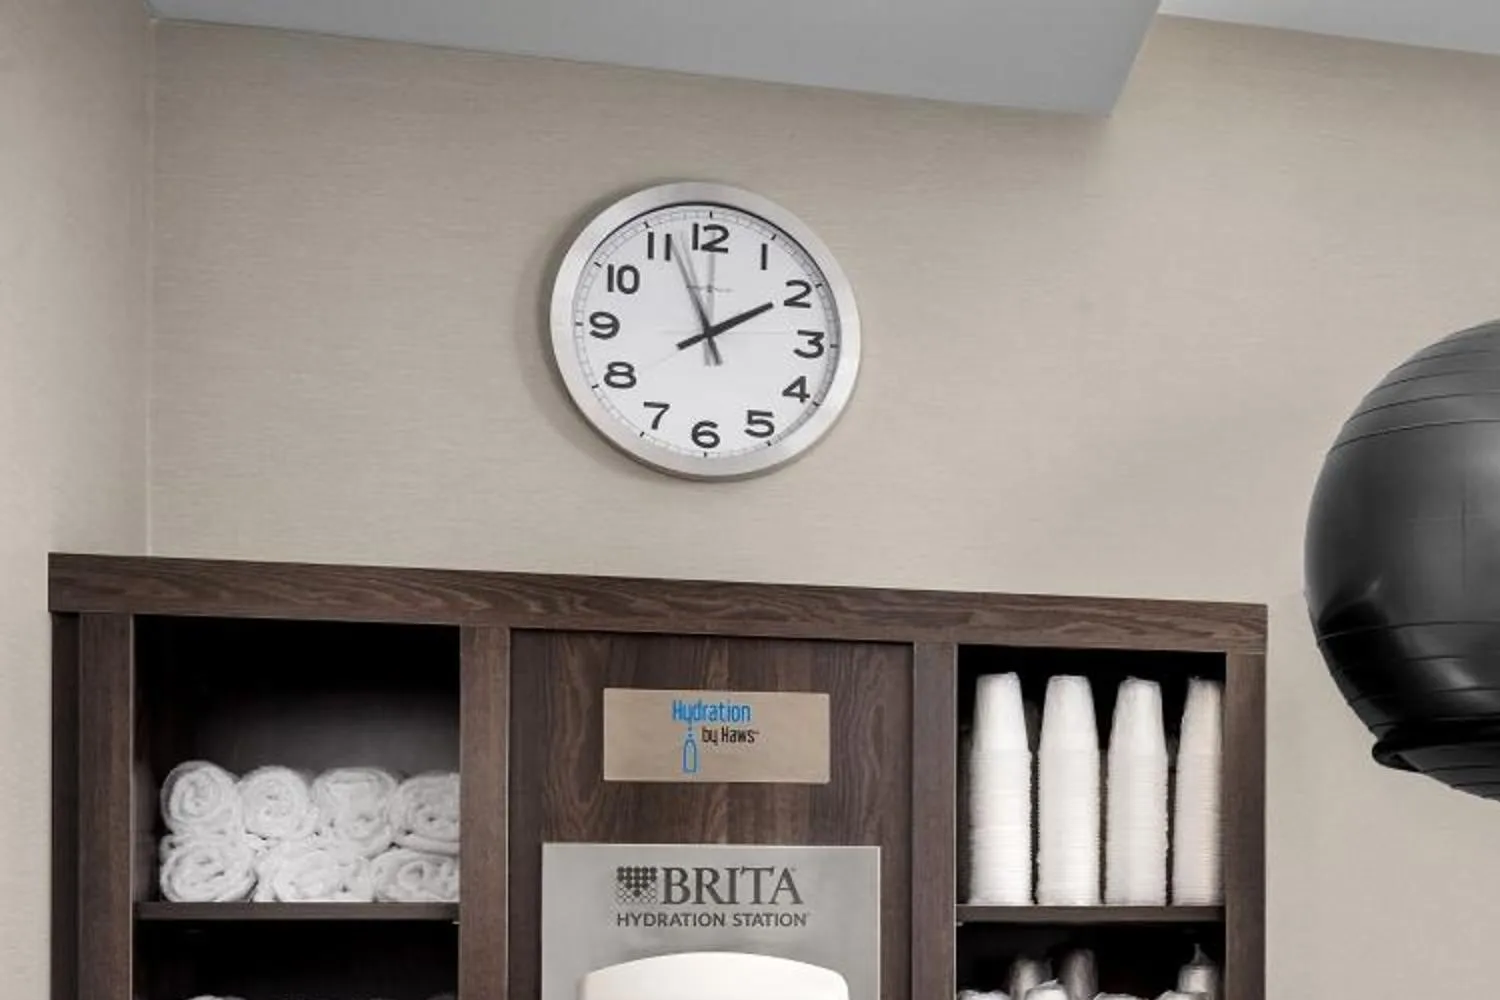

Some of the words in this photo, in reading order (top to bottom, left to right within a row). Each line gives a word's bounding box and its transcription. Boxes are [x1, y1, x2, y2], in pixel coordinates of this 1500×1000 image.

[647, 232, 672, 261] 11
[692, 223, 729, 253] 12
[761, 243, 768, 270] 1
[607, 264, 640, 294] 10
[783, 279, 812, 308] 2
[589, 311, 620, 340] 9
[793, 329, 825, 359] 3
[603, 361, 637, 389] 8
[781, 375, 810, 403] 4
[643, 401, 670, 430] 7
[744, 409, 775, 438] 5
[691, 420, 720, 449] 6
[671, 699, 752, 722] Hydration
[701, 726, 718, 746] by
[661, 867, 804, 905] BRITA
[616, 912, 725, 928] HYDRATION
[733, 912, 807, 928] STATION
